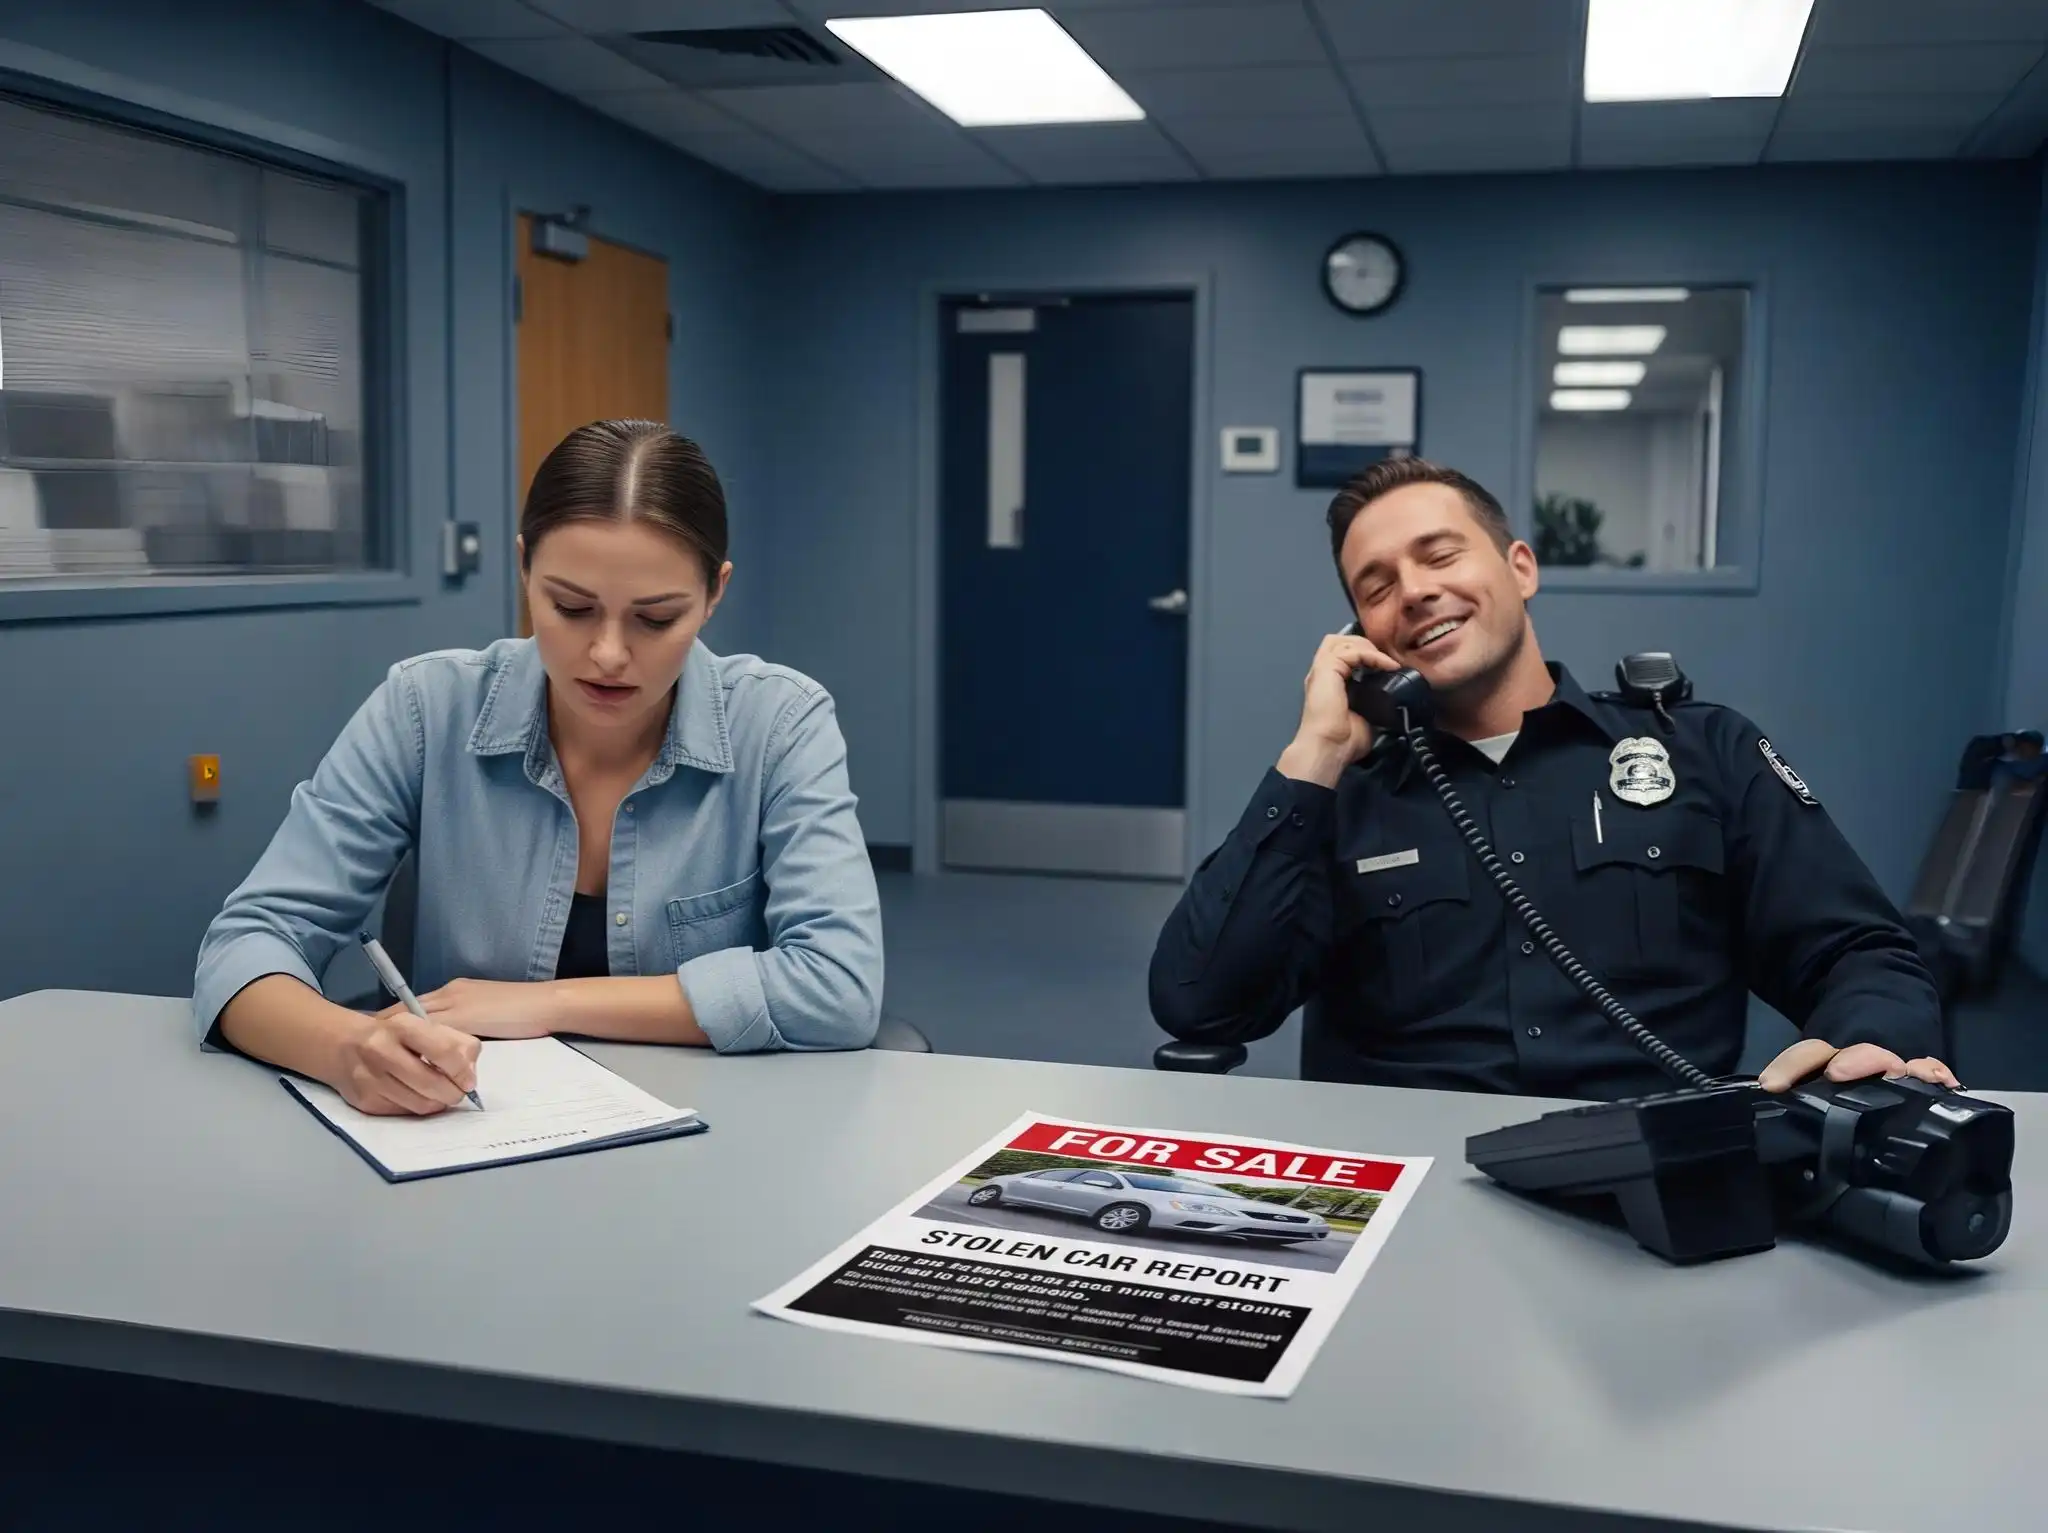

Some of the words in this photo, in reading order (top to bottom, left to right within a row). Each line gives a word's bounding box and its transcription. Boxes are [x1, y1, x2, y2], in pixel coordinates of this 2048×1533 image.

[1047, 1130, 1180, 1164] FOR
[1194, 1147, 1366, 1184] SALE
[921, 1230, 1060, 1261] STOLEN
[1063, 1250, 1138, 1272] CAR
[1143, 1260, 1290, 1293] REPORT
